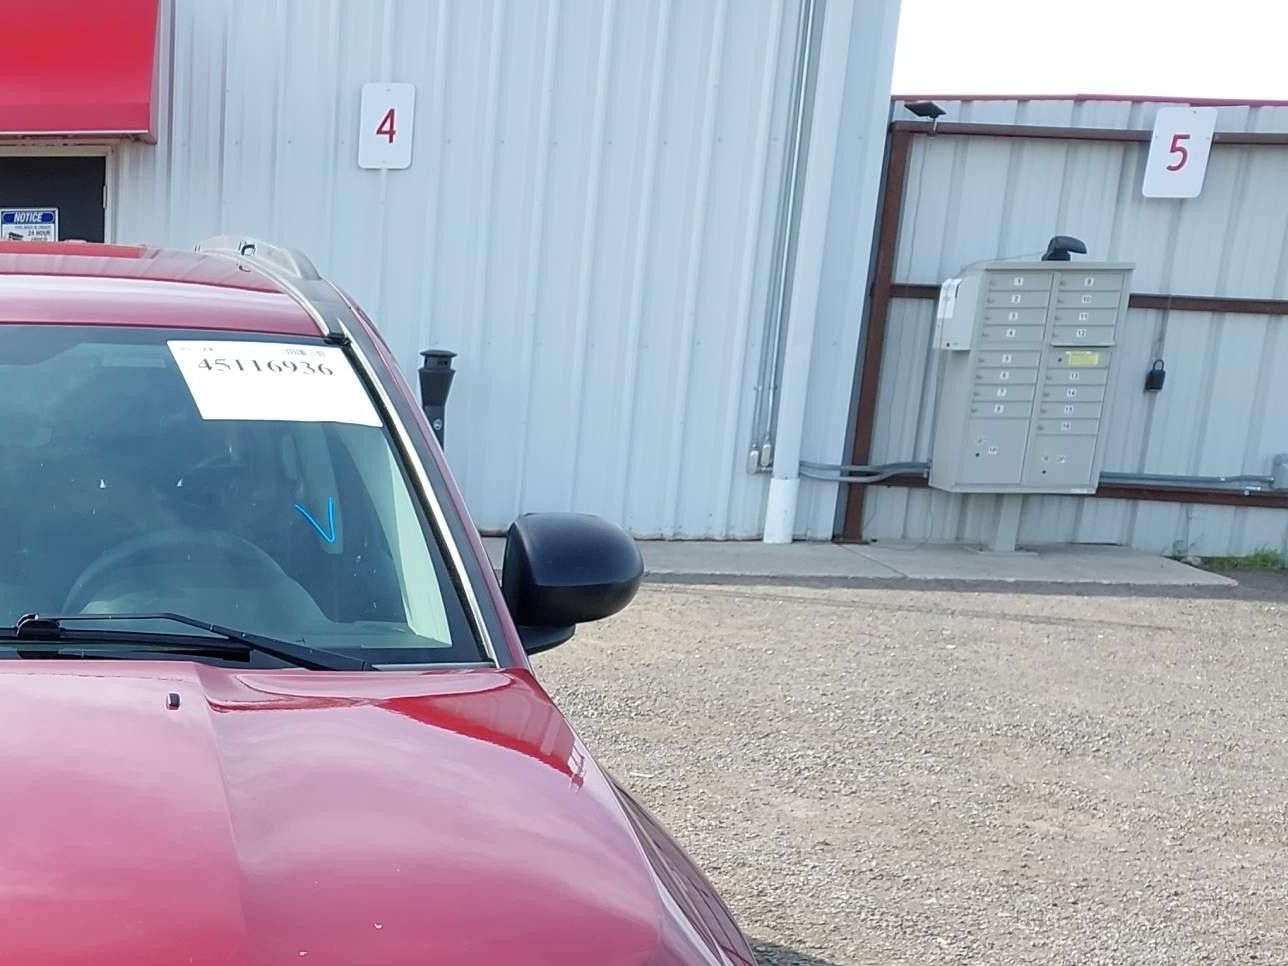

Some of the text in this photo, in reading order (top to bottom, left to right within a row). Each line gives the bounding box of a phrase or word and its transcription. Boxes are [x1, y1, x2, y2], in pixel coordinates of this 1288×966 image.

[376, 108, 397, 144] 4
[1166, 134, 1190, 172] 5
[14, 211, 43, 223] NOTICE
[198, 358, 334, 375] 45116936
